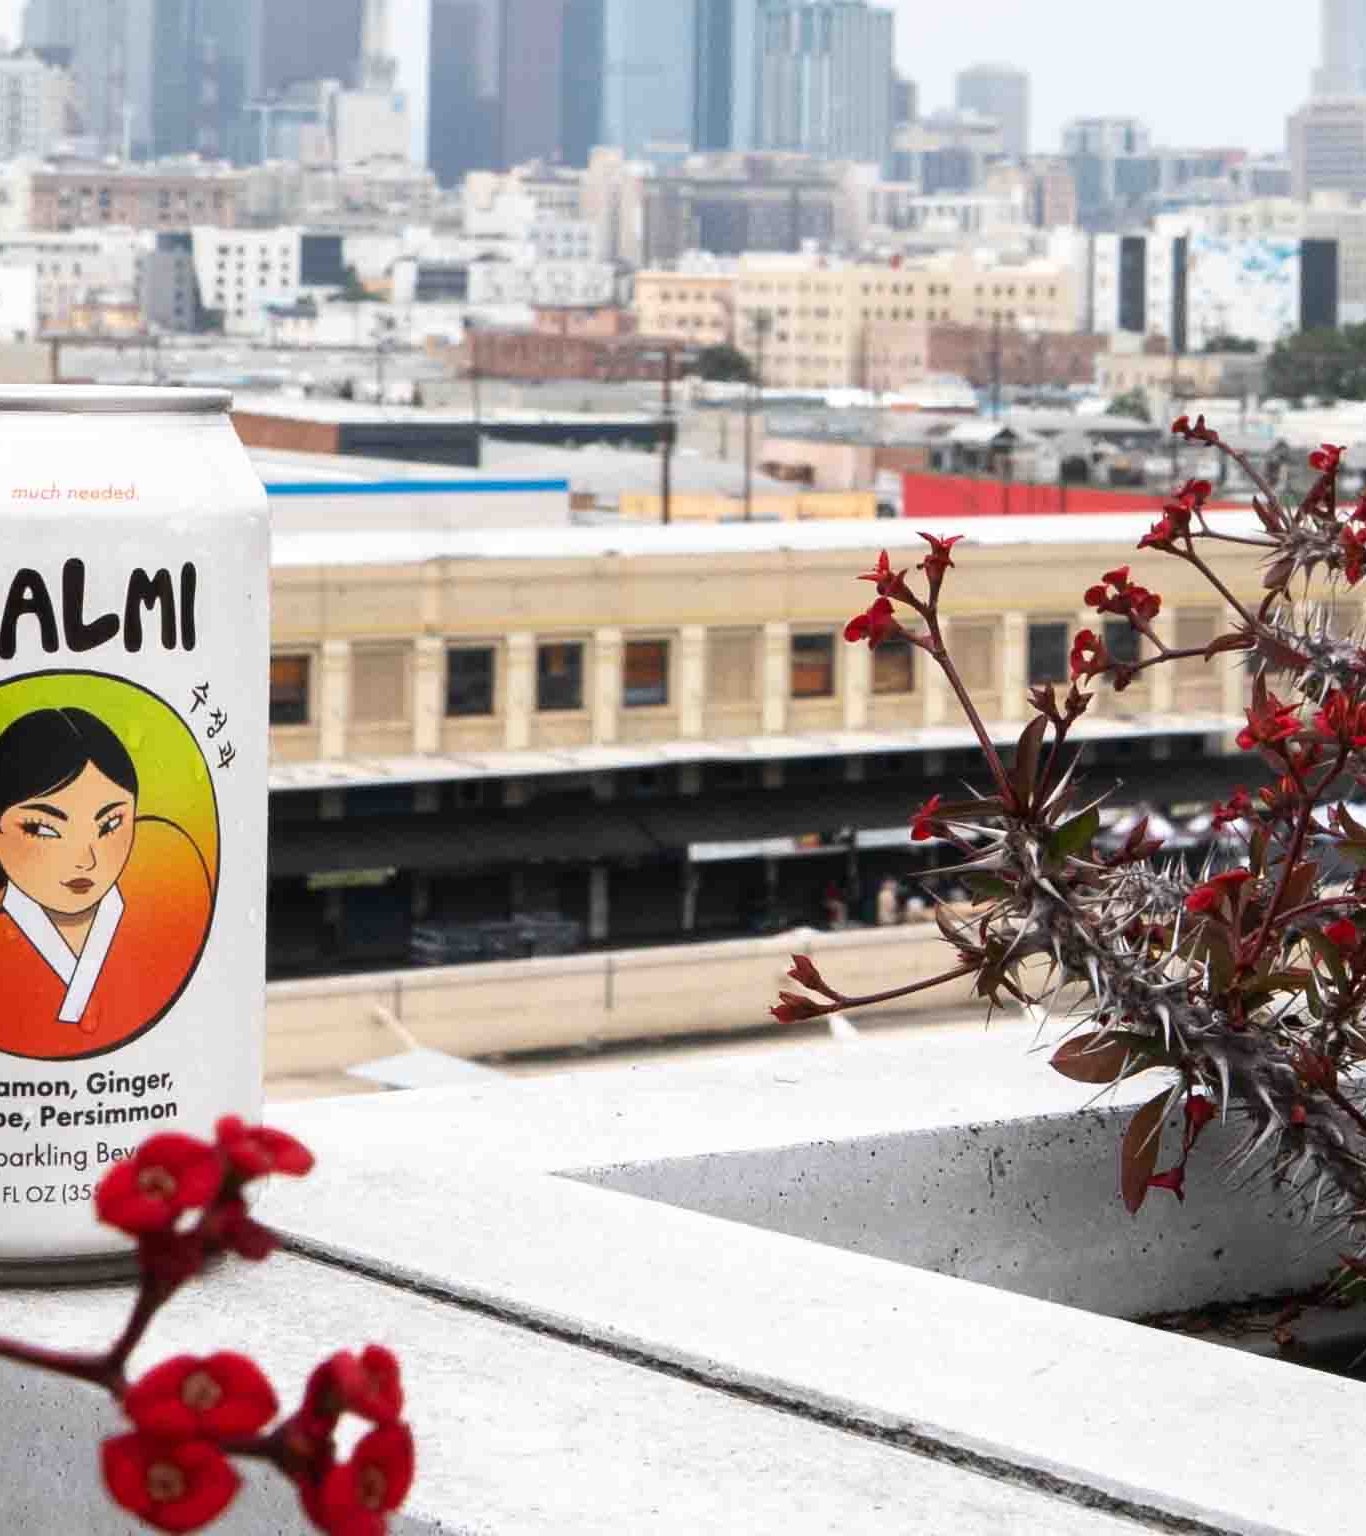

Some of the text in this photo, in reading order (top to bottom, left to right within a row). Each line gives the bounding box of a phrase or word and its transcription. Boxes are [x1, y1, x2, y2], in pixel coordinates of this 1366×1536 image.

[11, 480, 59, 500] much
[86, 1070, 174, 1098] Ginger,
[40, 1101, 178, 1127] Persimmon
[96, 1142, 139, 1163] Bev
[2, 1185, 20, 1203] FL
[26, 1185, 56, 1203] OZ
[62, 1183, 98, 1204] (35
